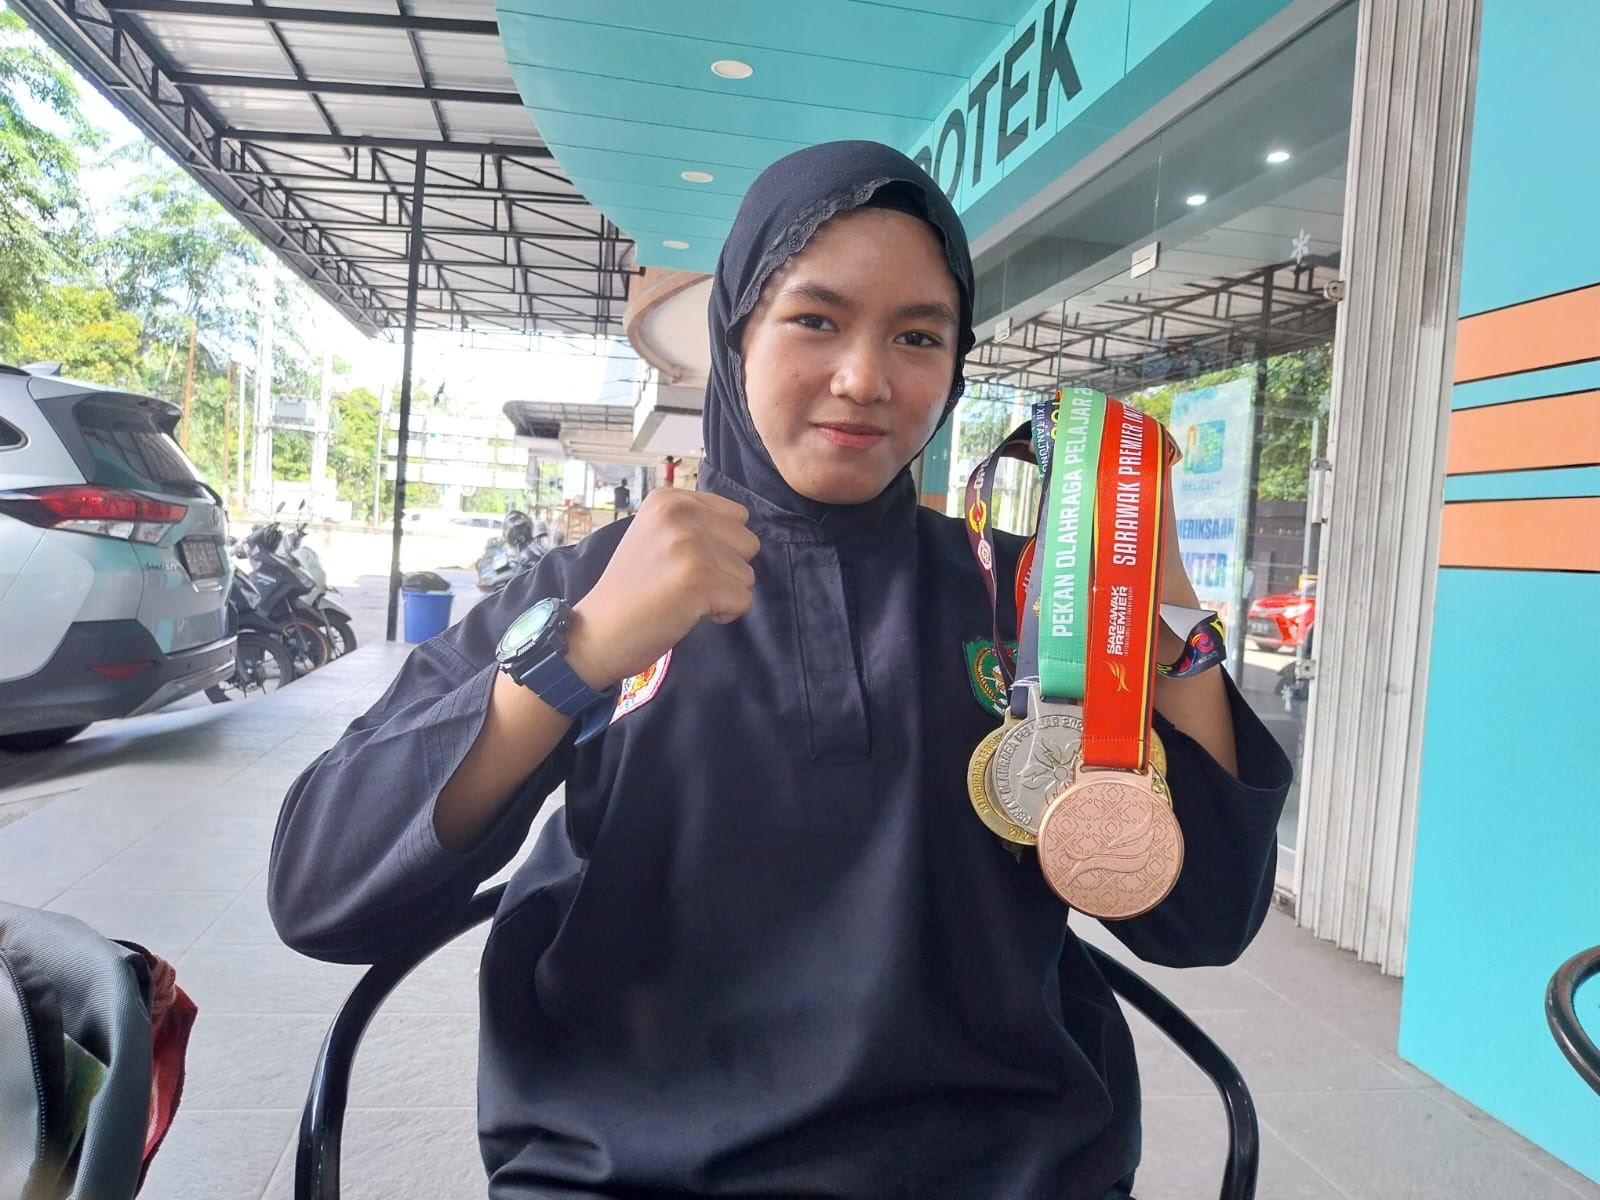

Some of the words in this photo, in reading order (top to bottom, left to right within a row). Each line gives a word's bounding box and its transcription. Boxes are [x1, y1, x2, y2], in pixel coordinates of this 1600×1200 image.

[1063, 397, 1092, 466] PELAJAR
[1118, 422, 1143, 476] PREMIER
[1055, 468, 1084, 570] OLAHRAGA
[1112, 482, 1141, 567] SARAWAK
[1051, 577, 1076, 638] PEKAN
[1106, 585, 1120, 655] SARAWAK
[1114, 586, 1128, 656] PREMIER
